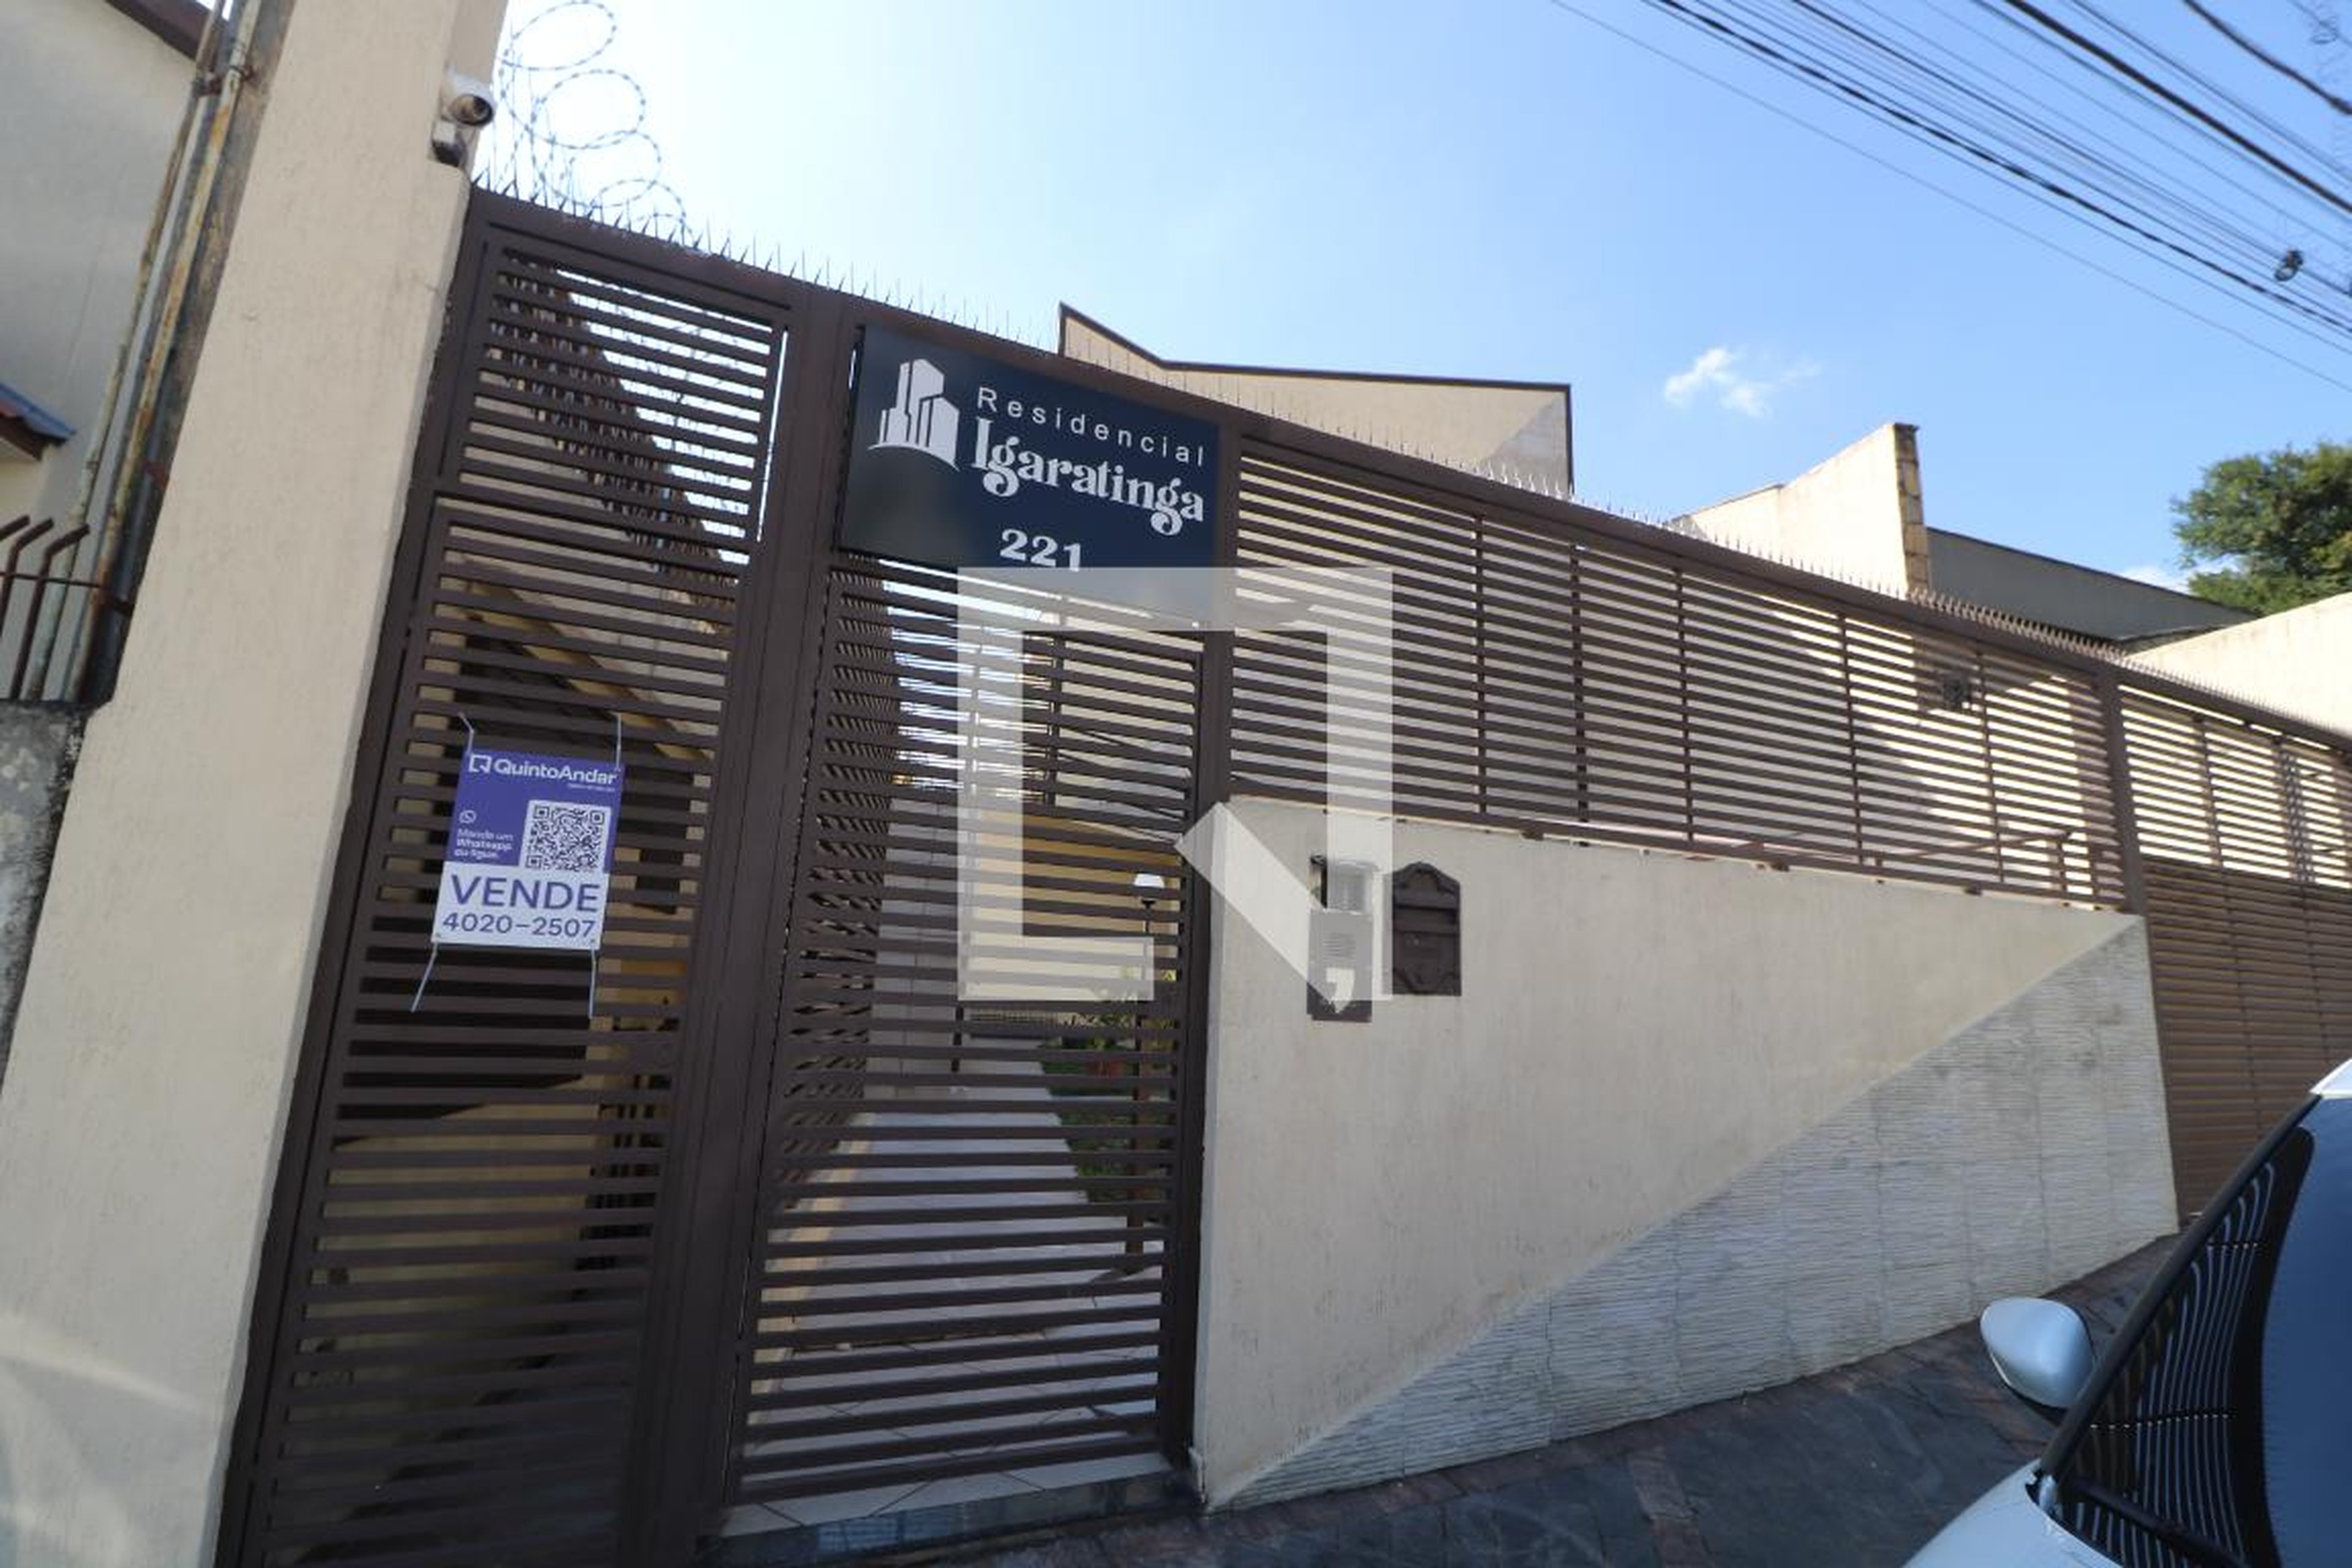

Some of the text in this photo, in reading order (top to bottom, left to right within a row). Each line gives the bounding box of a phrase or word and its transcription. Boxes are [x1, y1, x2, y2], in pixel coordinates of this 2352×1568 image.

[978, 386, 1204, 467] Residencial
[971, 417, 1204, 536] Igaratinga
[1000, 529, 1082, 572] 221
[494, 758, 617, 785] QuintoAndar
[451, 875, 601, 913] VENDE
[443, 912, 596, 938] 4020-2507
